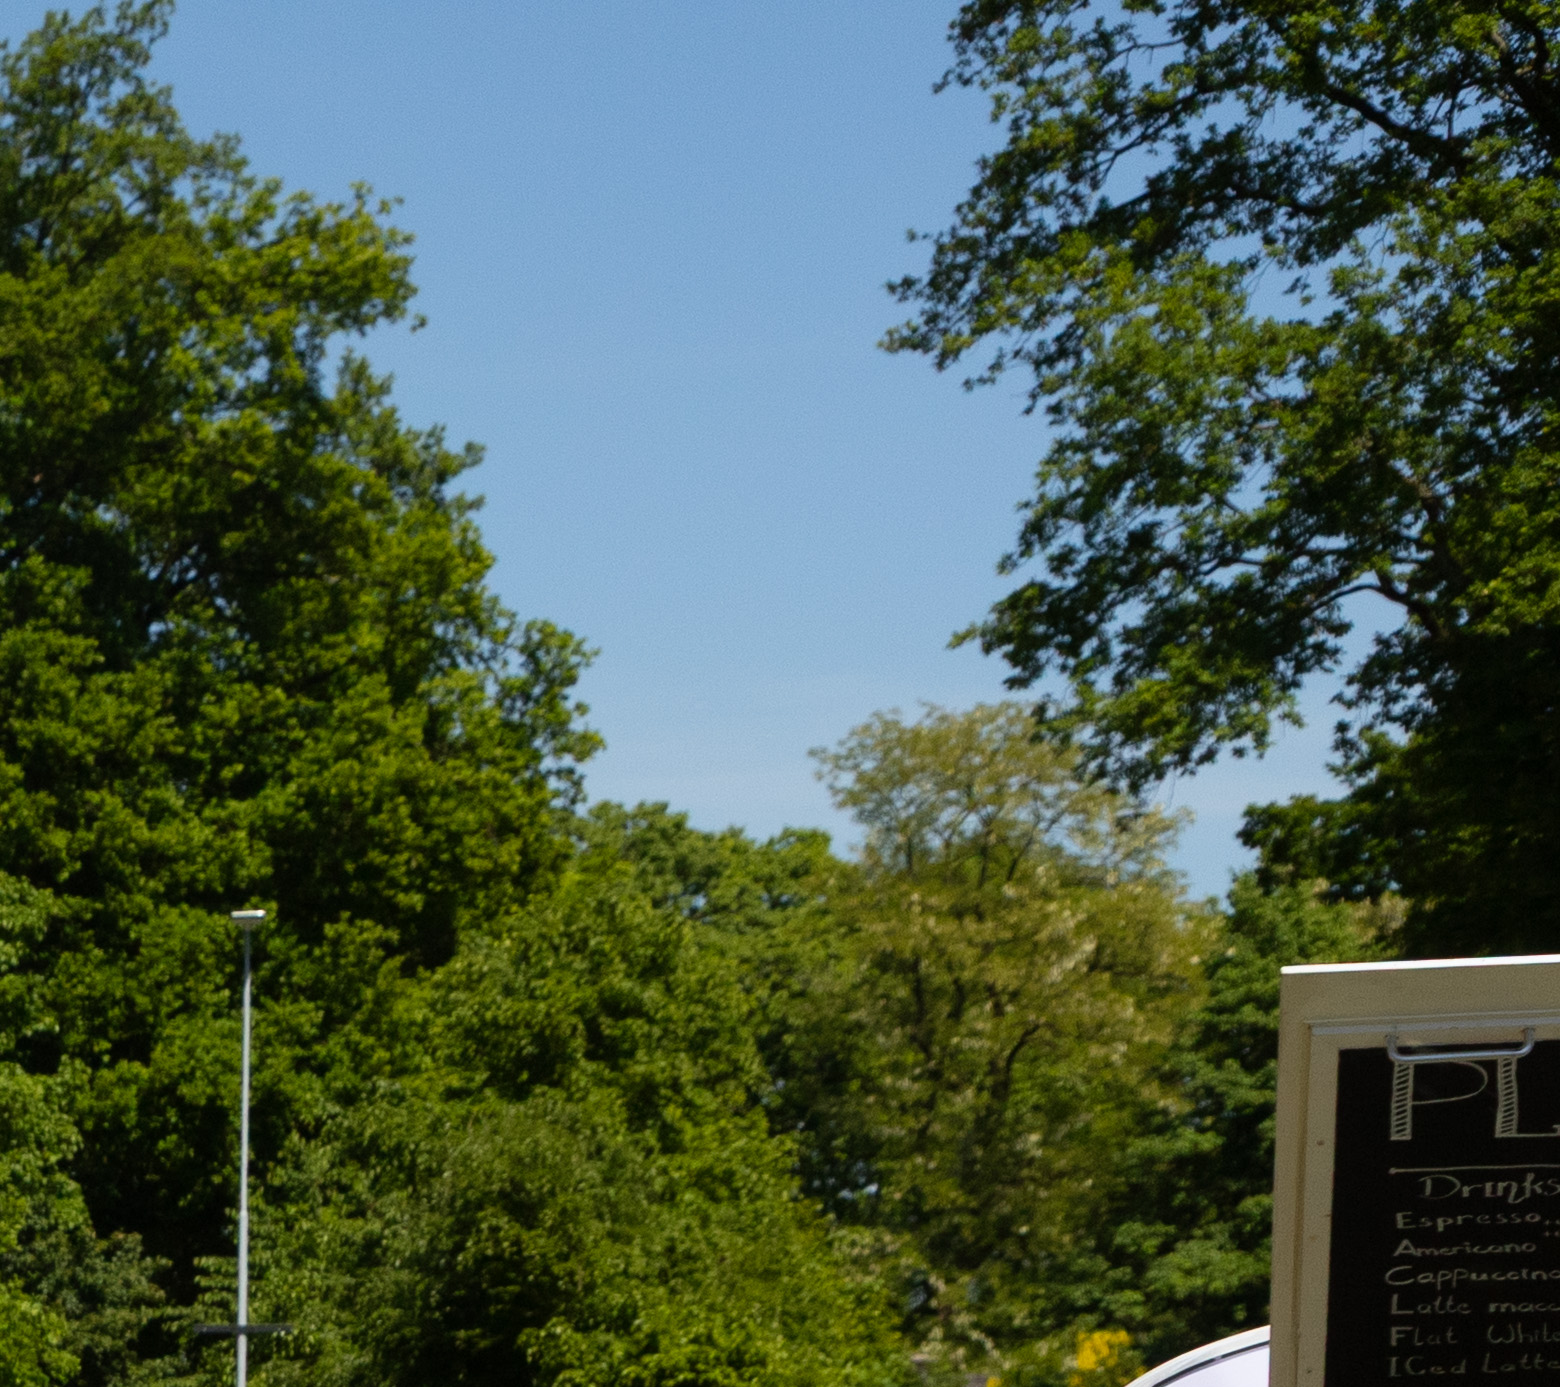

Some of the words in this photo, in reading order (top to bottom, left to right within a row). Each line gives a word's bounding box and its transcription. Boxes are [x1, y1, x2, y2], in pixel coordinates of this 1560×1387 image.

[1392, 1238, 1537, 1257] Americano
[1389, 1293, 1472, 1315] Latte
[1389, 1325, 1459, 1347] Flat
[1486, 1321, 1560, 1345] White
[1482, 1352, 1560, 1374] Latte
